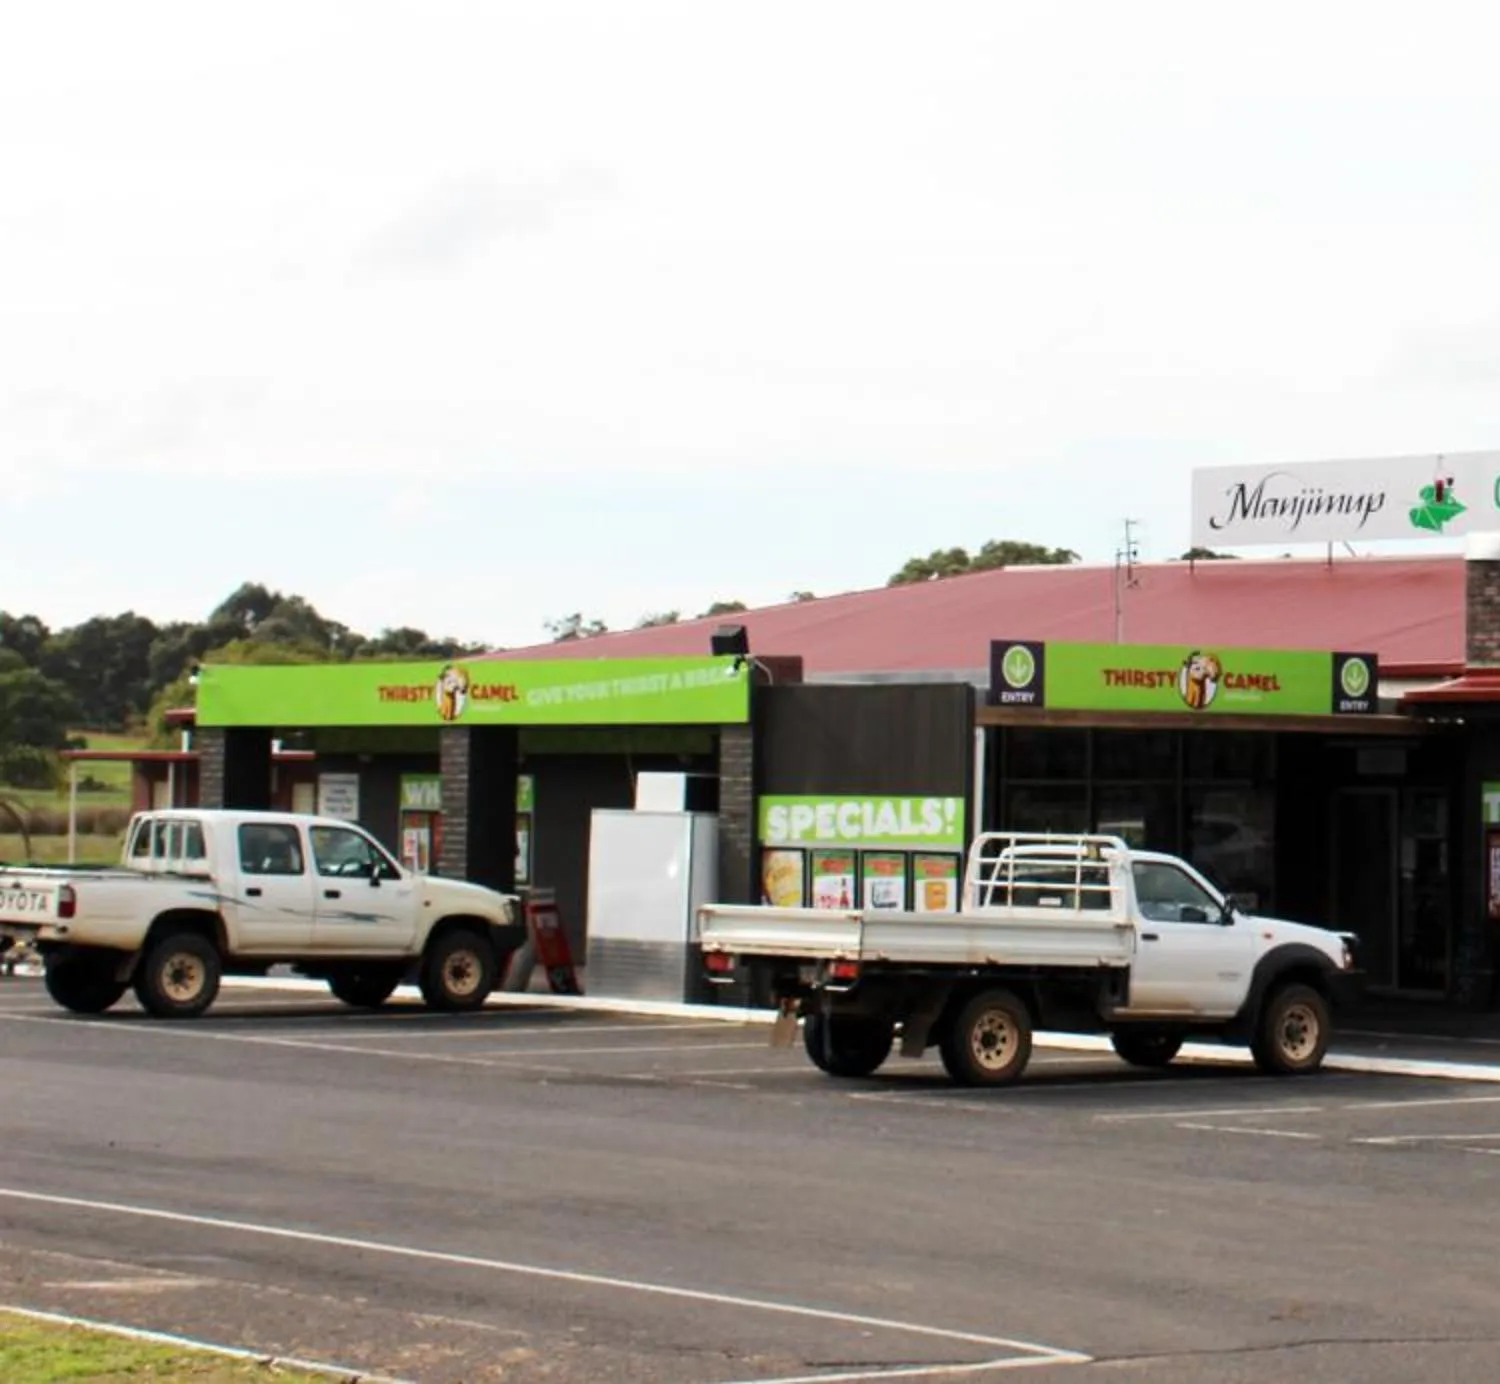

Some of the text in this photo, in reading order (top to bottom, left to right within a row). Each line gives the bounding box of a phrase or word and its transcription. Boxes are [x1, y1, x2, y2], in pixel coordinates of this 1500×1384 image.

[1209, 471, 1386, 534] Manjimup
[1103, 669, 1281, 692] THIRSTY CAMEL
[378, 685, 519, 702] THIRSTY CAMEL
[1001, 692, 1034, 704] ENTRY
[1340, 700, 1369, 712] ENTRY
[766, 797, 957, 843] SPECIALS!
